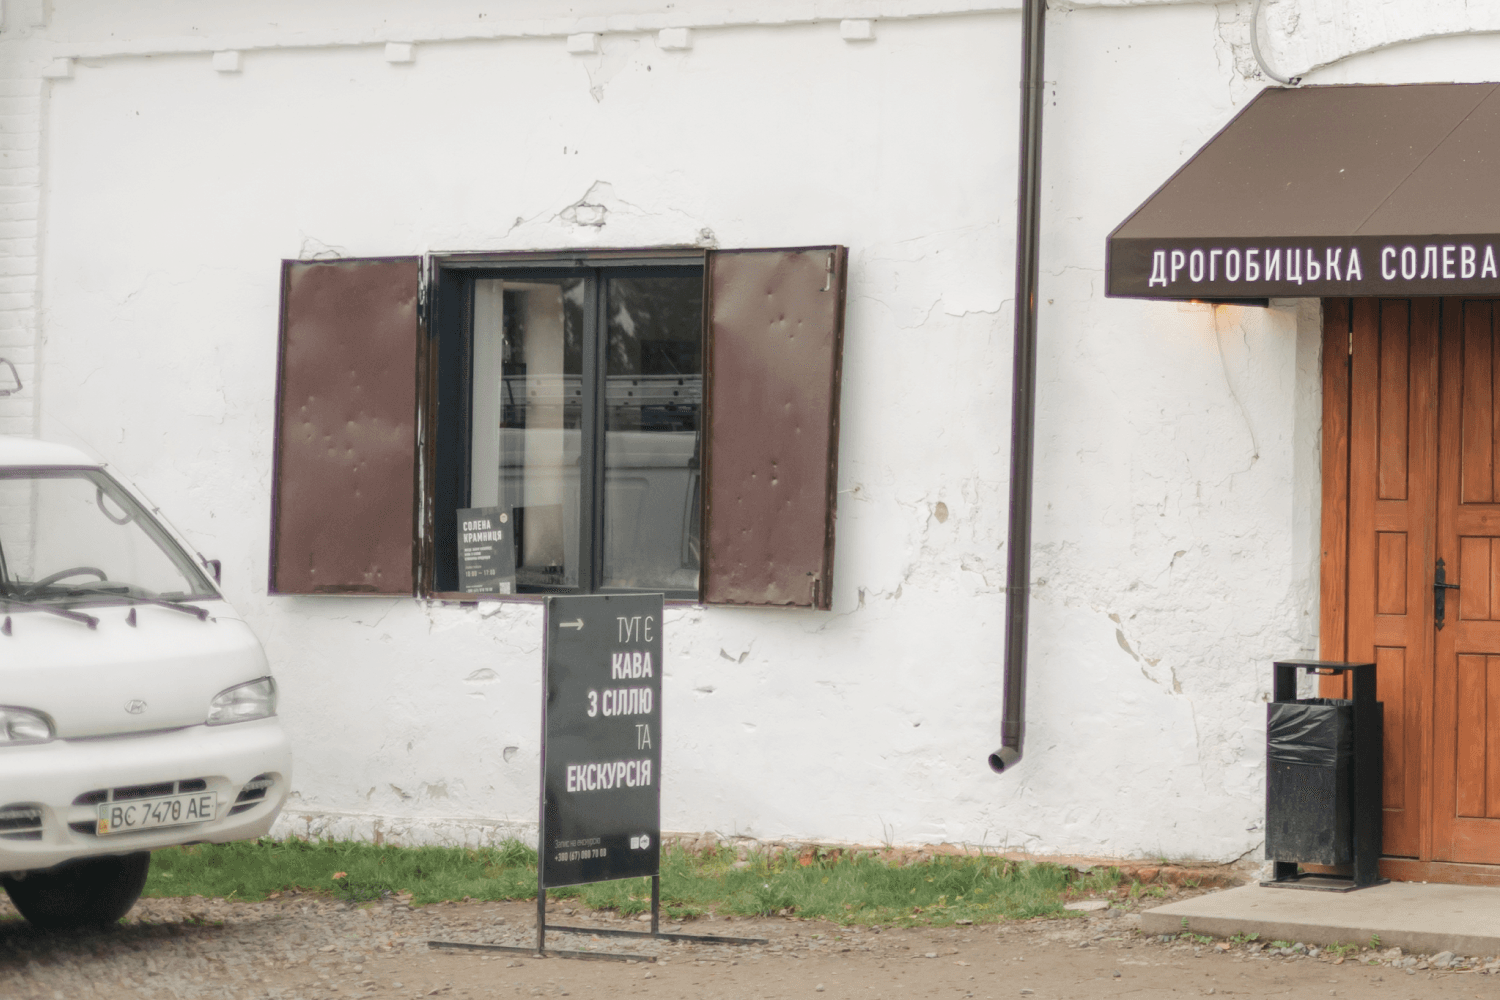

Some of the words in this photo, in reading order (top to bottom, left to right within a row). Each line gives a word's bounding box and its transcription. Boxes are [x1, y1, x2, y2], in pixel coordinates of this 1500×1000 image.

[1148, 247, 1363, 288] ДРОГОБИЦЬКА
[463, 520, 491, 531] СОЛЕНА
[463, 530, 502, 543] КРАМНИЦЯ
[616, 615, 642, 643] ТУТ
[644, 615, 654, 643] Є
[612, 651, 653, 680] КАВА
[587, 690, 598, 718] З
[602, 687, 653, 717] СІЛЛЮ
[635, 723, 652, 750] ТА
[566, 759, 651, 793] ЕКСКУРСІЯ
[142, 800, 182, 825] 7470
